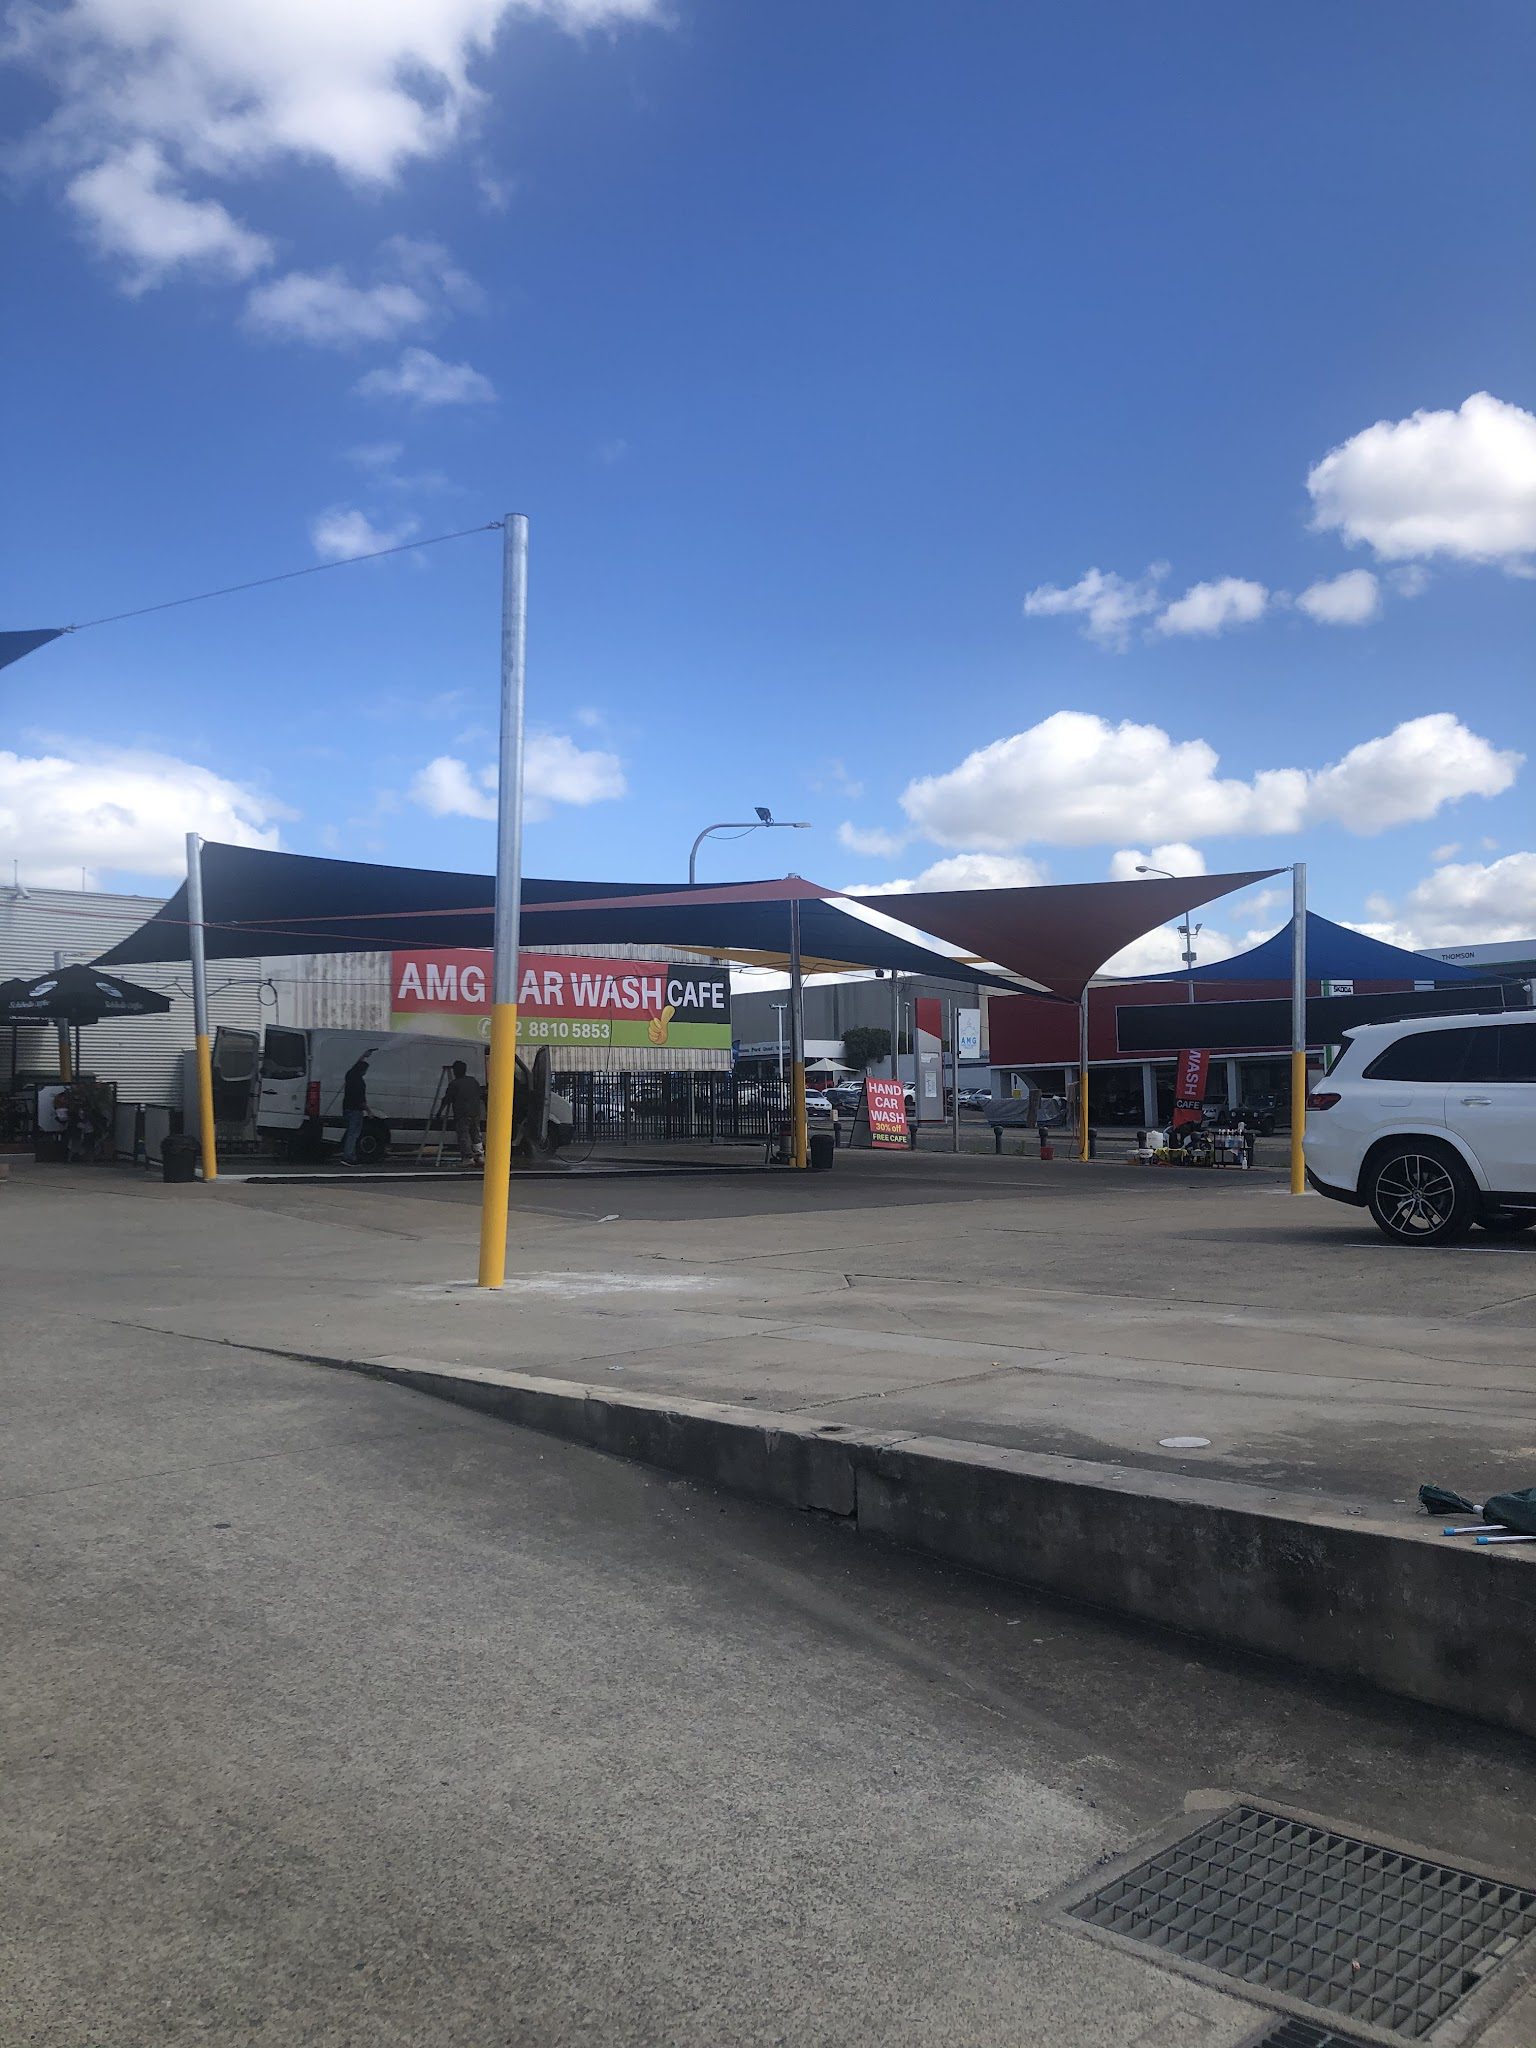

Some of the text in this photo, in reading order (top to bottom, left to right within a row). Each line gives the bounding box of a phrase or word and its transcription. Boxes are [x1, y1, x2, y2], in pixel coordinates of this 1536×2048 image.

[1441, 951, 1475, 961] THOMSON
[397, 962, 725, 1010] AMG AR WASH CAFE
[528, 1022, 569, 1038] 8810
[572, 1023, 610, 1039] 5853
[961, 1036, 977, 1044] AMG
[1184, 1050, 1201, 1095] WASH
[868, 1082, 902, 1096] HAND
[875, 1097, 899, 1110] CAR
[1176, 1100, 1200, 1110] CAFE
[870, 1110, 905, 1124] WASH
[875, 1123, 902, 1133] 30% off
[873, 1133, 907, 1143] FREE CAFE
